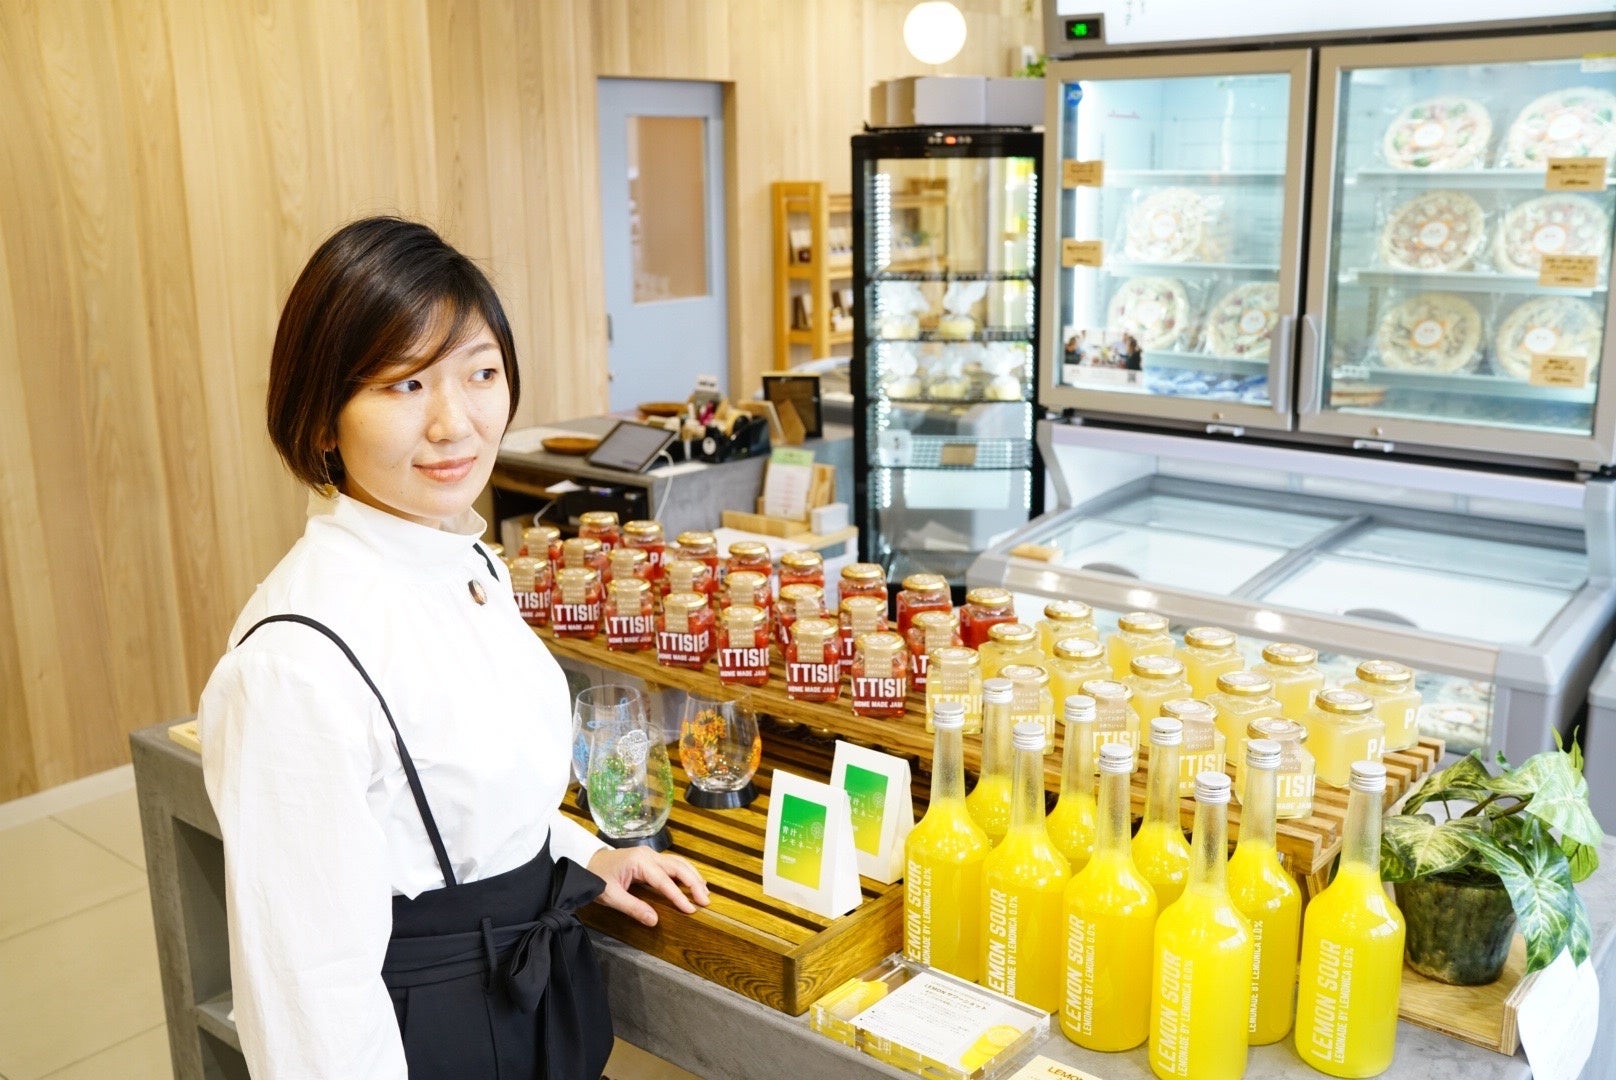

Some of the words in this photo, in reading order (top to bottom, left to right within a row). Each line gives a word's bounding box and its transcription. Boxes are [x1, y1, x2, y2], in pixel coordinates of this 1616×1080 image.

[908, 860, 922, 908] SOUR
[989, 887, 1007, 938] SOUR
[1067, 913, 1085, 965] SOUR
[988, 939, 1007, 993] EMON
[1085, 945, 1096, 983] LEMONICA
[1161, 949, 1181, 1004] SOUR
[1317, 939, 1342, 993] SOUR
[1065, 966, 1083, 1033] LEMON
[1086, 984, 1094, 995] BY
[1181, 982, 1193, 1023] LEMONICA
[1339, 970, 1353, 1009] LEMONICA
[1082, 998, 1093, 1036] LEMONADE
[1180, 1024, 1190, 1035] BY
[1310, 993, 1336, 1061] LEMON
[1342, 1008, 1350, 1022] BY
[1158, 1004, 1179, 1074] LEMON
[1177, 1038, 1190, 1077] LEMONADE
[1335, 1022, 1349, 1064] LEMONADE
